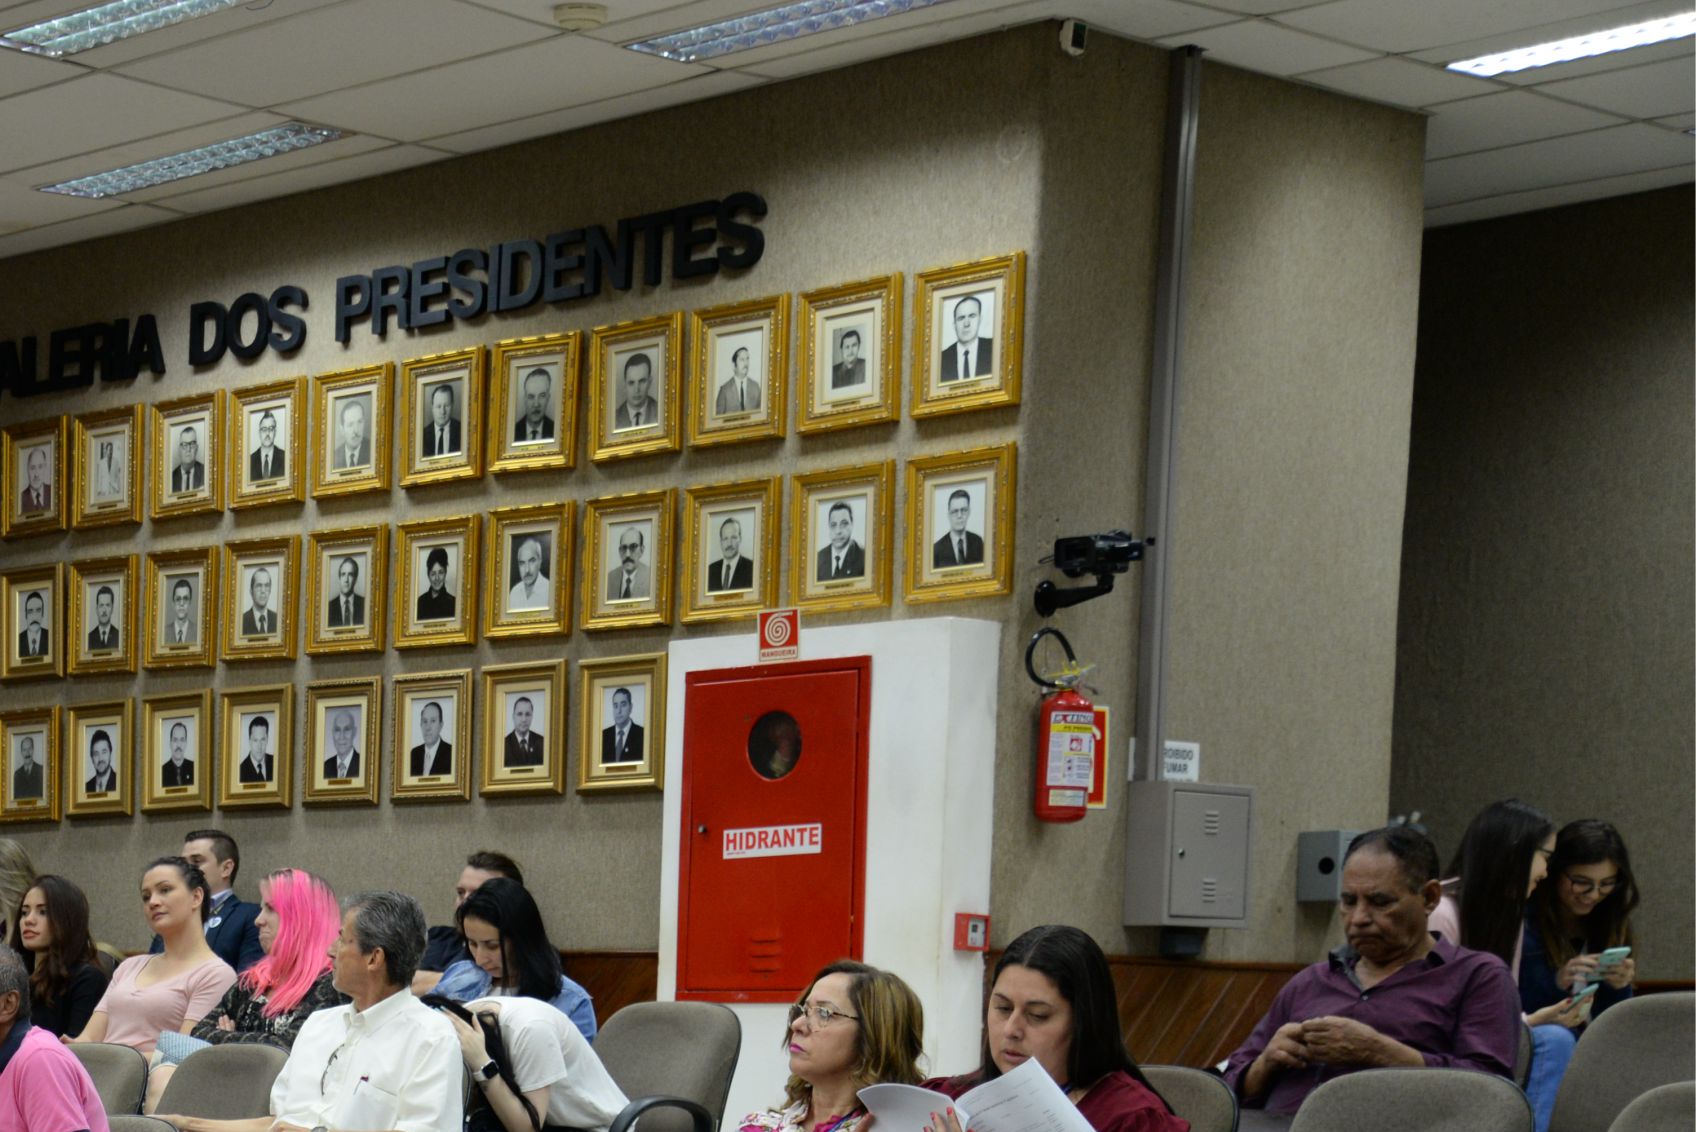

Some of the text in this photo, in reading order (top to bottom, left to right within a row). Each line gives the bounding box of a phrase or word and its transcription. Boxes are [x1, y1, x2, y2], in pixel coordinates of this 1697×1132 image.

[189, 284, 310, 368] DOS
[335, 191, 768, 344] PRESIDENTES
[1163, 748, 1194, 761] ROIBIDO
[725, 826, 820, 851] HIDRANTE
